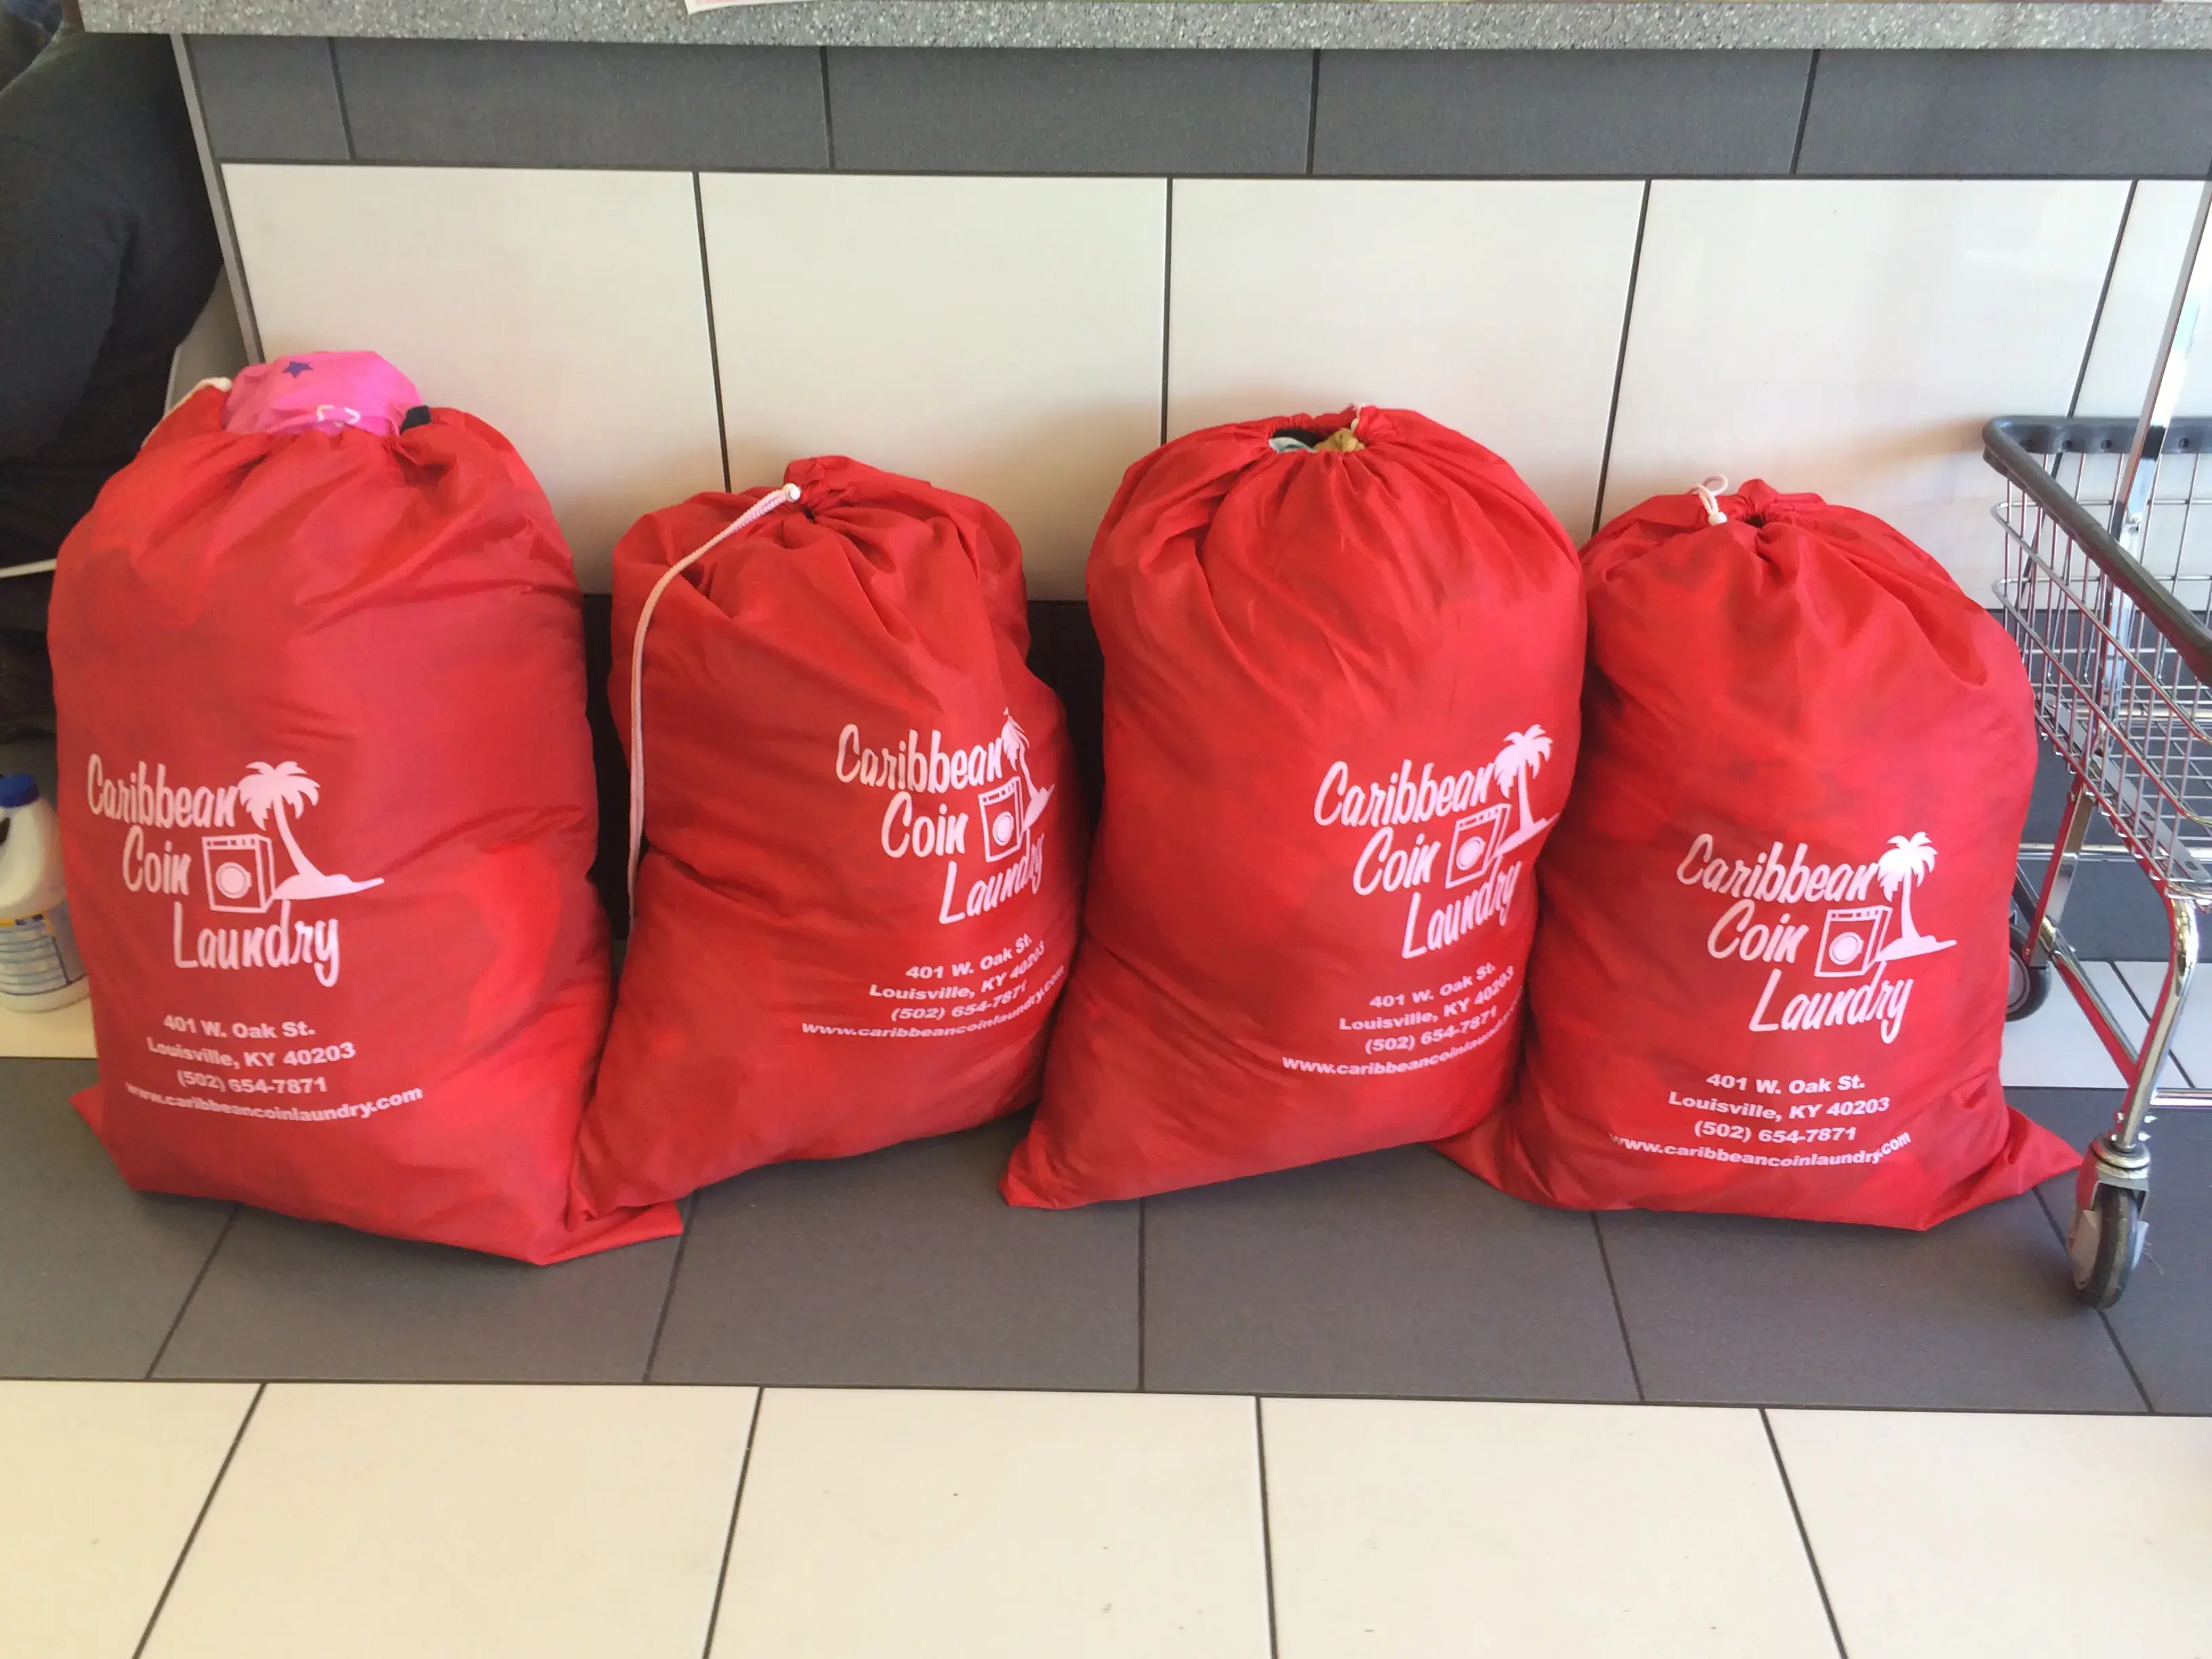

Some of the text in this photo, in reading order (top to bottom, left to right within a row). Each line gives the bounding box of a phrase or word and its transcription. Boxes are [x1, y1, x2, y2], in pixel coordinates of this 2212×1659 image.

[87, 753, 240, 828] Caribbean
[835, 723, 1003, 794] Caribbean
[880, 791, 969, 859] Coin
[1313, 758, 1496, 827] Caribbean
[122, 825, 192, 896] Coin
[938, 828, 1045, 925] Laundry
[1352, 827, 1441, 898] Coin
[1676, 833, 1877, 905] Caribbean
[1401, 857, 1523, 960] Laundry
[1706, 899, 1809, 964] Coin
[173, 899, 340, 988] Laundry
[905, 933, 1033, 979] 401 W. Oak St.
[869, 983, 976, 1000] Louisville,
[980, 971, 1008, 993] KY
[890, 979, 1027, 1022] (502) 654-7871
[1338, 965, 1514, 1031] Louisville, KY 40203
[1368, 993, 1406, 1008] 401
[1411, 989, 1435, 1004] W.
[1439, 975, 1473, 996] Oak
[1748, 961, 1914, 1044] Laundry
[146, 1036, 356, 1069] Louisville, KY 40203
[163, 1015, 316, 1039] 401 W. Oak St.
[1364, 1005, 1497, 1055] (502) 654-7871
[177, 1069, 328, 1094] (502) 654-7871
[1668, 1090, 1891, 1122] Louisville, KY 40203
[1706, 1073, 1866, 1094] 401 W. Oak St.
[1694, 1120, 1857, 1144] (502) 654-7871
